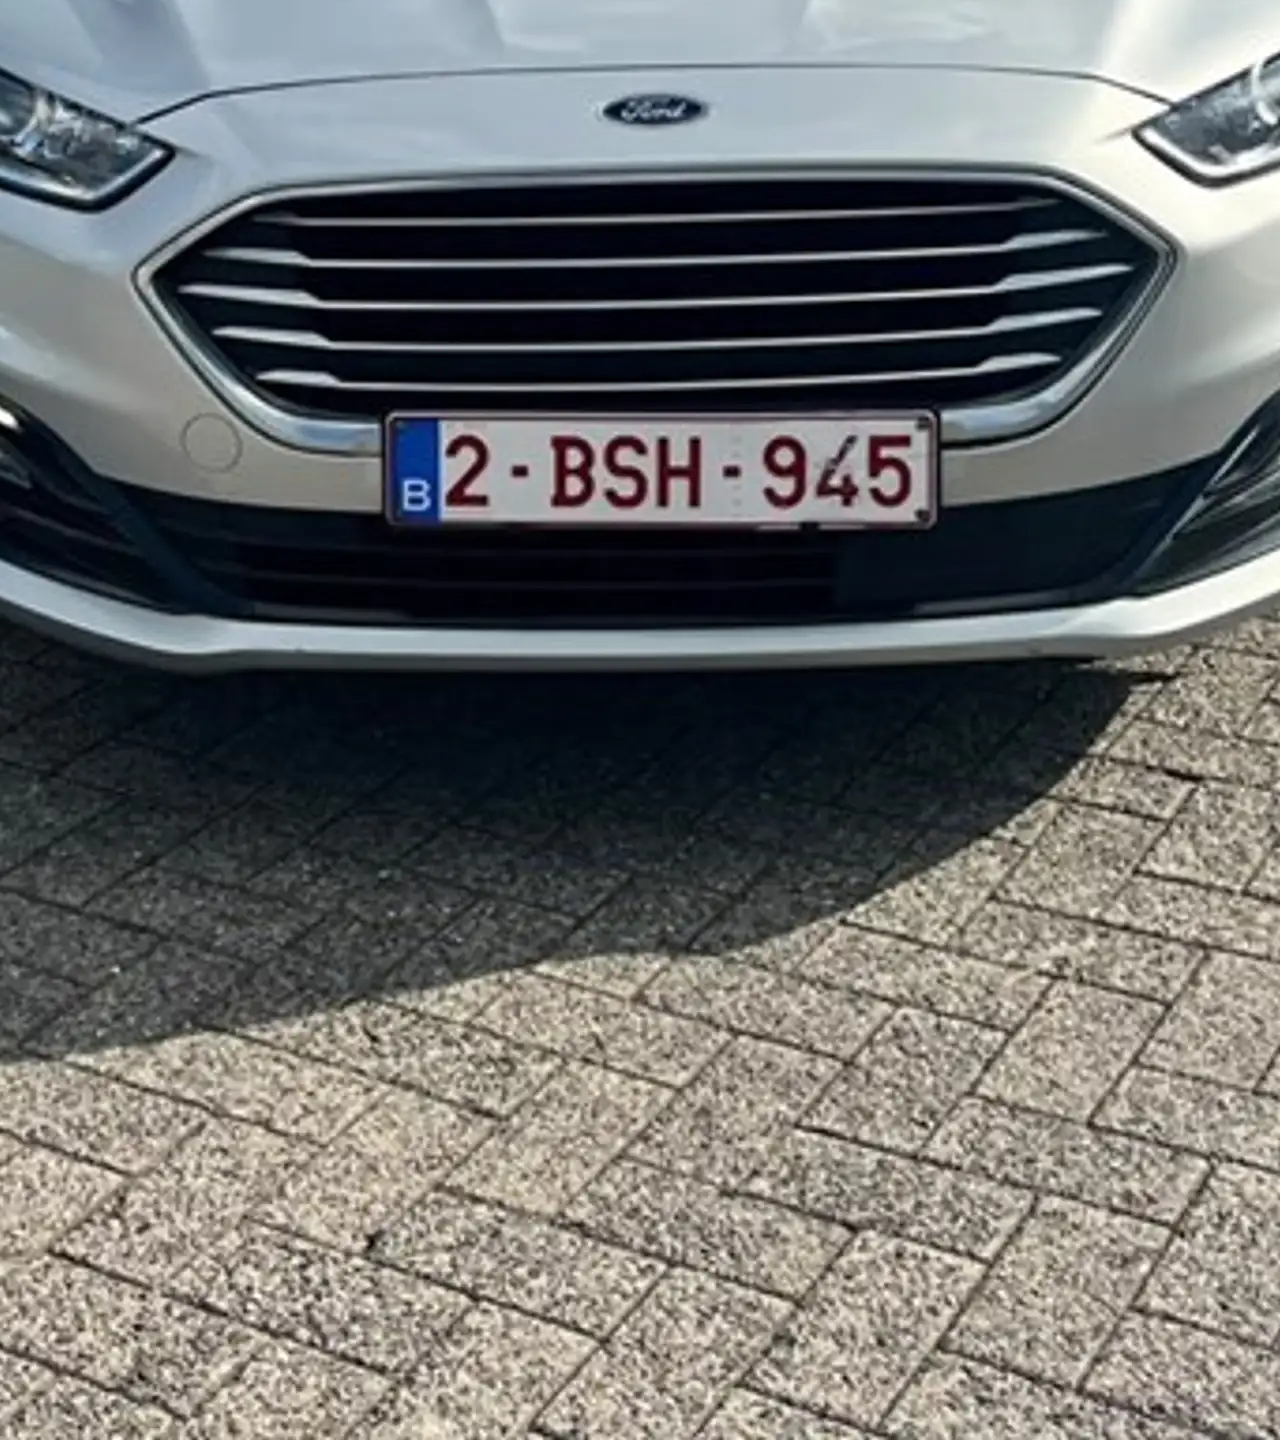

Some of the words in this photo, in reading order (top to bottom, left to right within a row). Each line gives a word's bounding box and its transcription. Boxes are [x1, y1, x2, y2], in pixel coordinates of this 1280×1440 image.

[621, 100, 687, 122] Ford
[402, 480, 432, 511] B
[444, 434, 913, 509] 2-BSH-945
